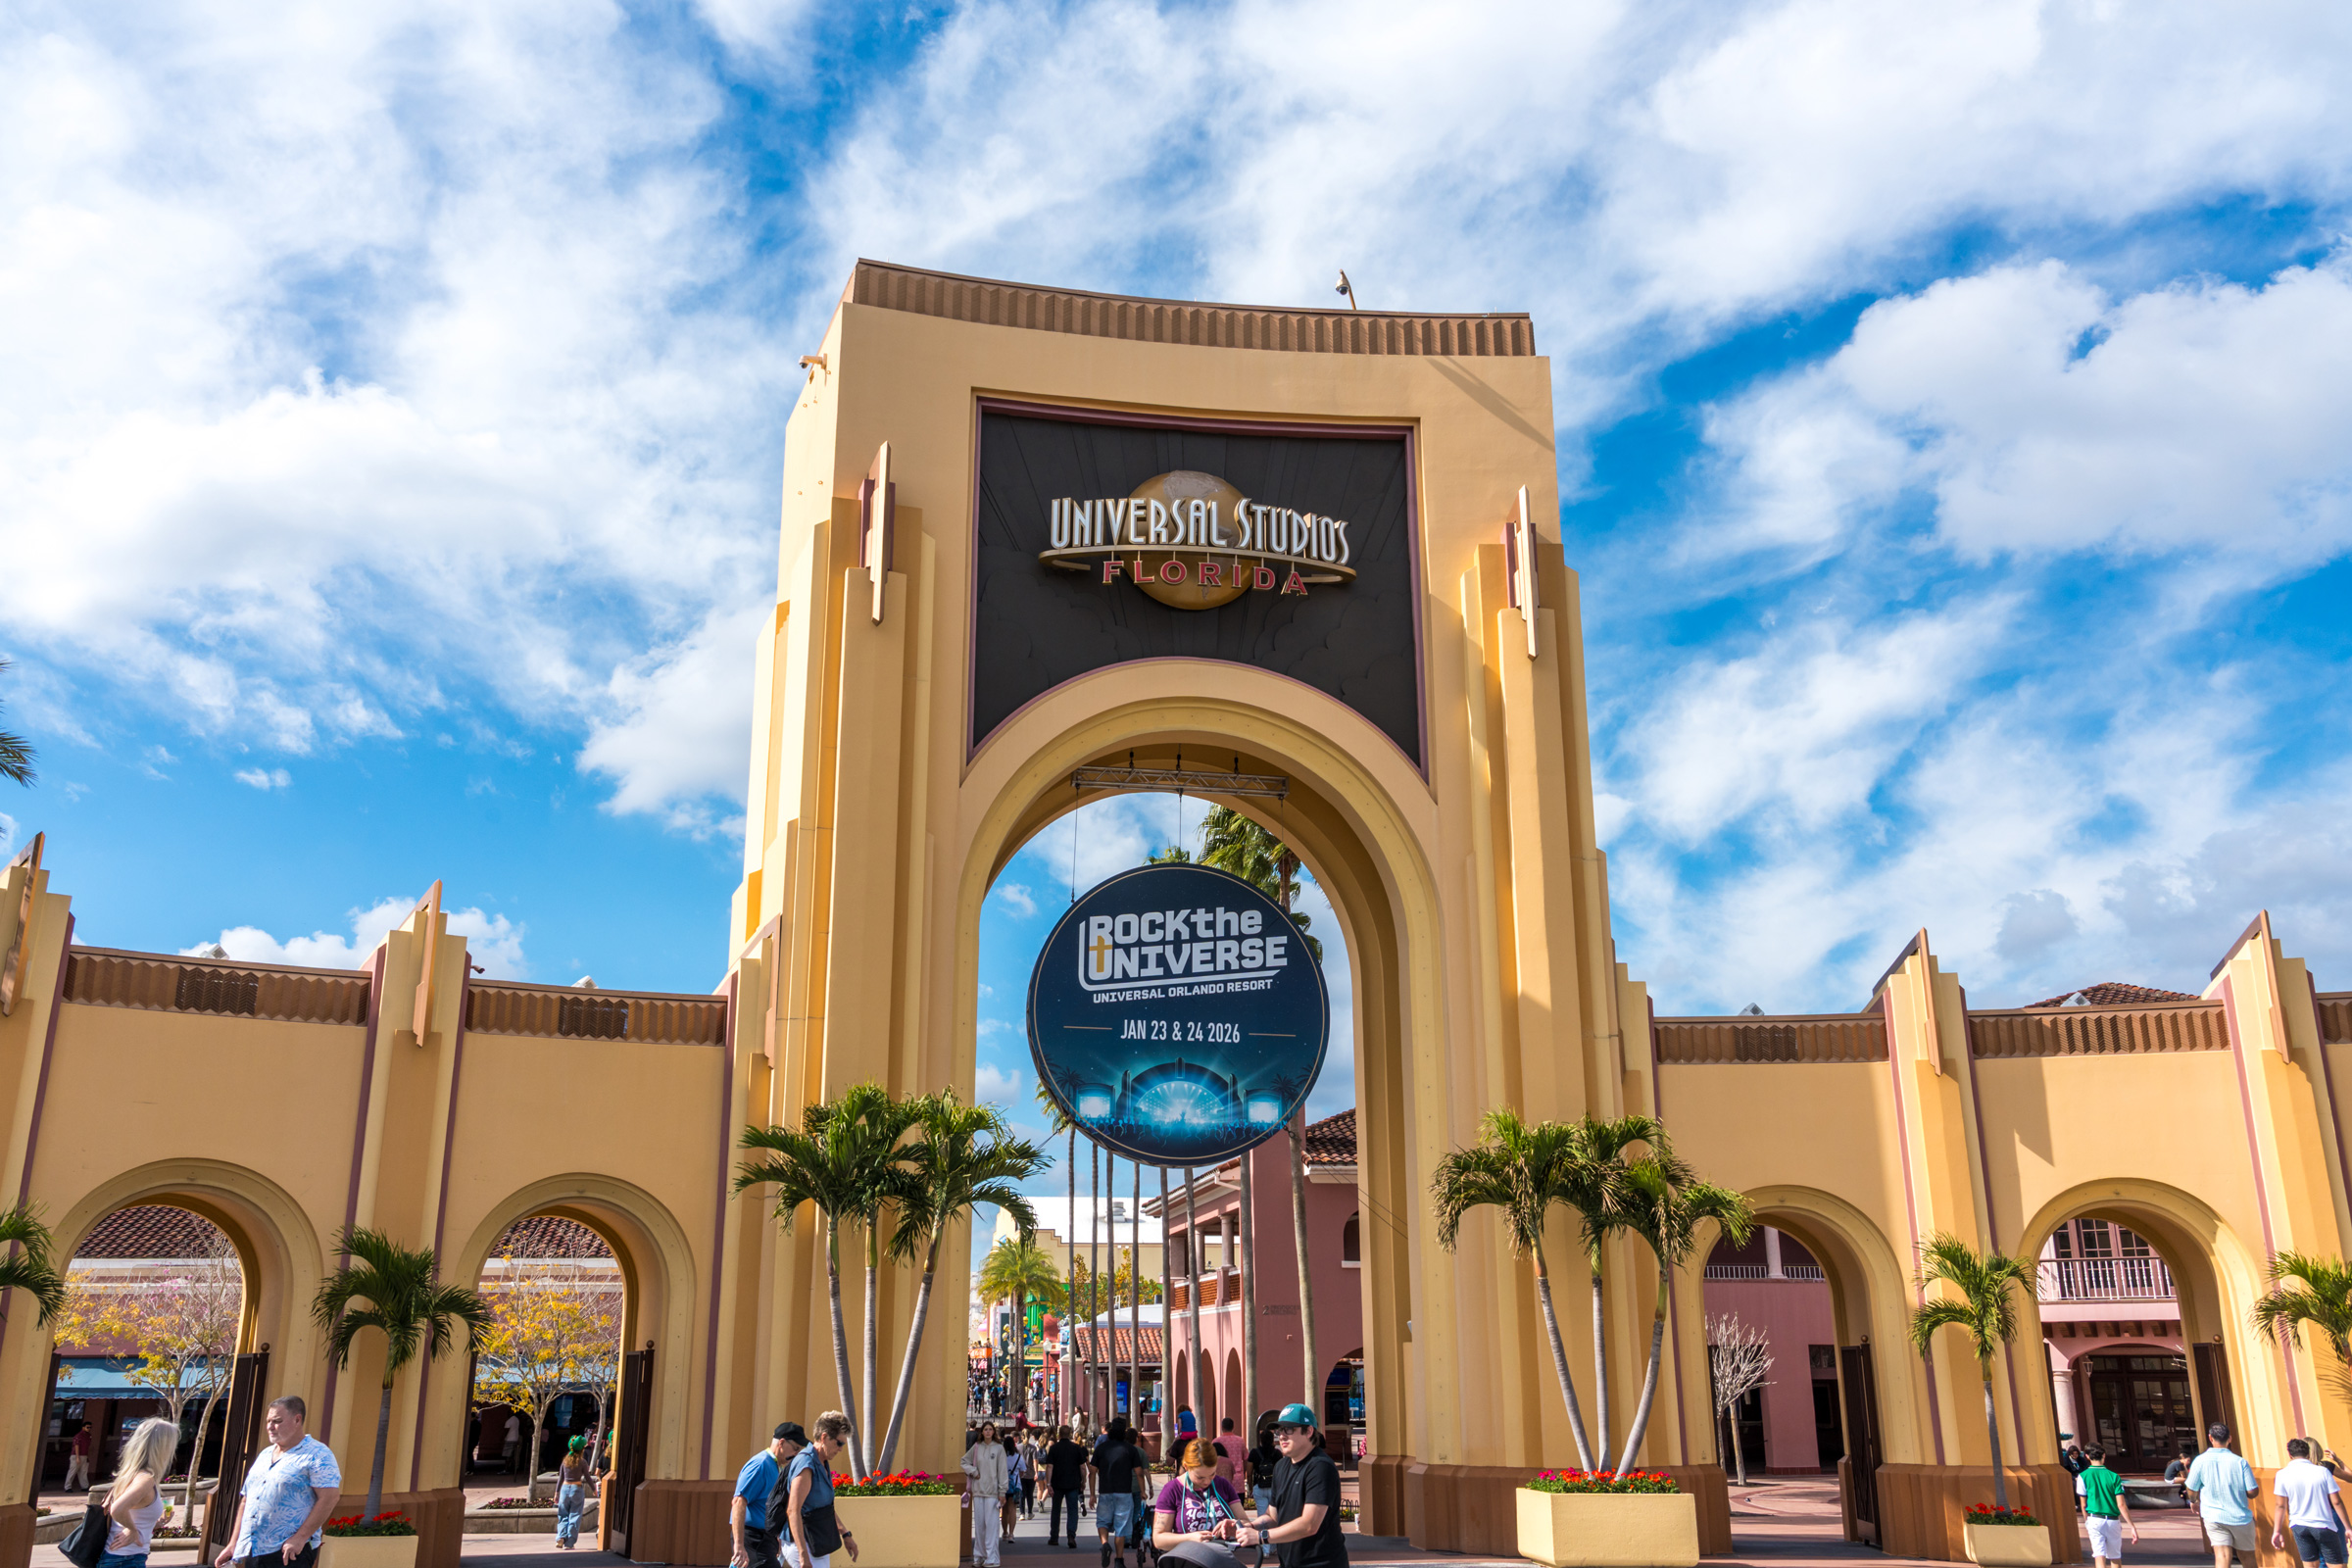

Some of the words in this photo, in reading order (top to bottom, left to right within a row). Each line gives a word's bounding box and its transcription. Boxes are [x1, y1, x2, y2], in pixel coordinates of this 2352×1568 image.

[1051, 497, 1227, 550] UNIVERSAL
[1234, 498, 1350, 566] STUDIOS
[1102, 560, 1308, 596] FLORIDA
[1088, 935, 1288, 981] UNIVERSE
[1093, 988, 1165, 1004] UNIVERSAL
[1168, 983, 1224, 998] ORLANDO
[1226, 979, 1273, 993] RESORT
[1120, 1019, 1147, 1040] JAN
[1151, 1020, 1167, 1040] 23
[1171, 1021, 1182, 1041] &
[1187, 1022, 1203, 1042] 24
[1207, 1022, 1241, 1043] 2026
